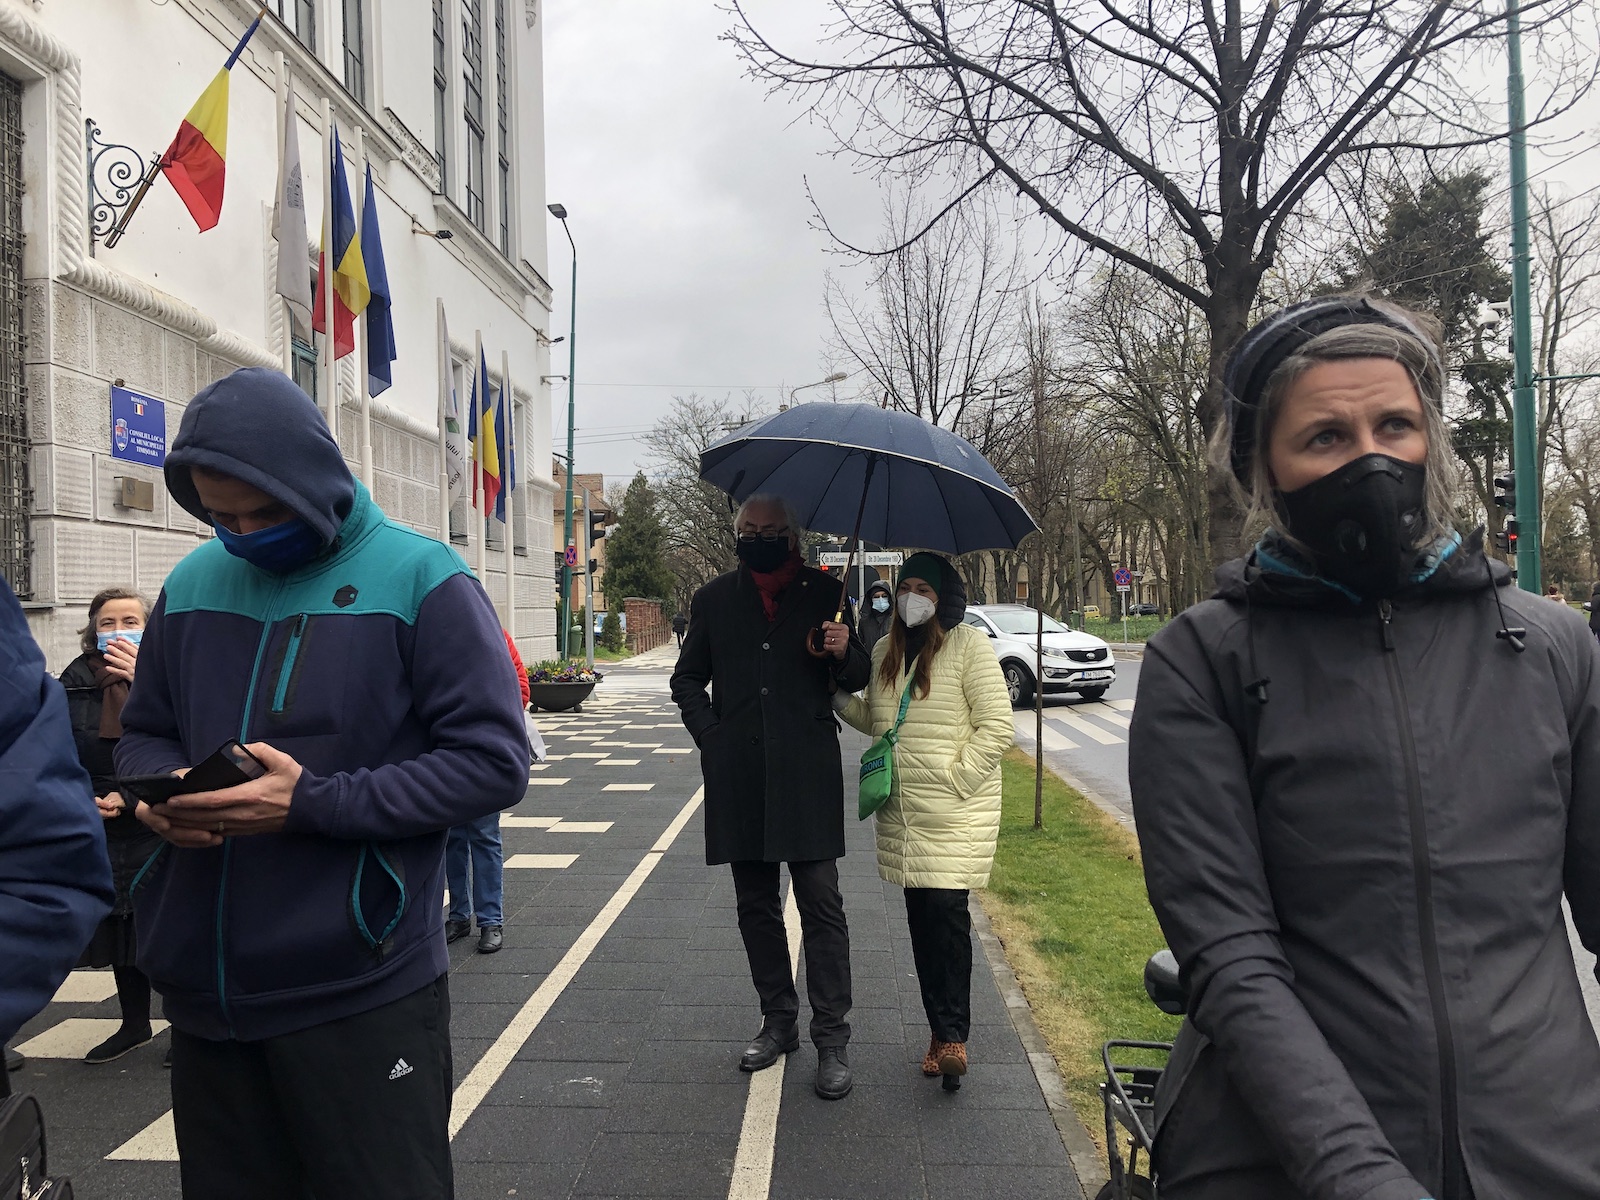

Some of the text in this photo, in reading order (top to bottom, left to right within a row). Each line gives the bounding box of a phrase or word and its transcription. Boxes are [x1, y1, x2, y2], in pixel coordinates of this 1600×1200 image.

[129, 429, 164, 444] CONSILIUL LOCAL
[136, 438, 164, 451] MUNICIPIULUI
[389, 1065, 413, 1080] adidas
